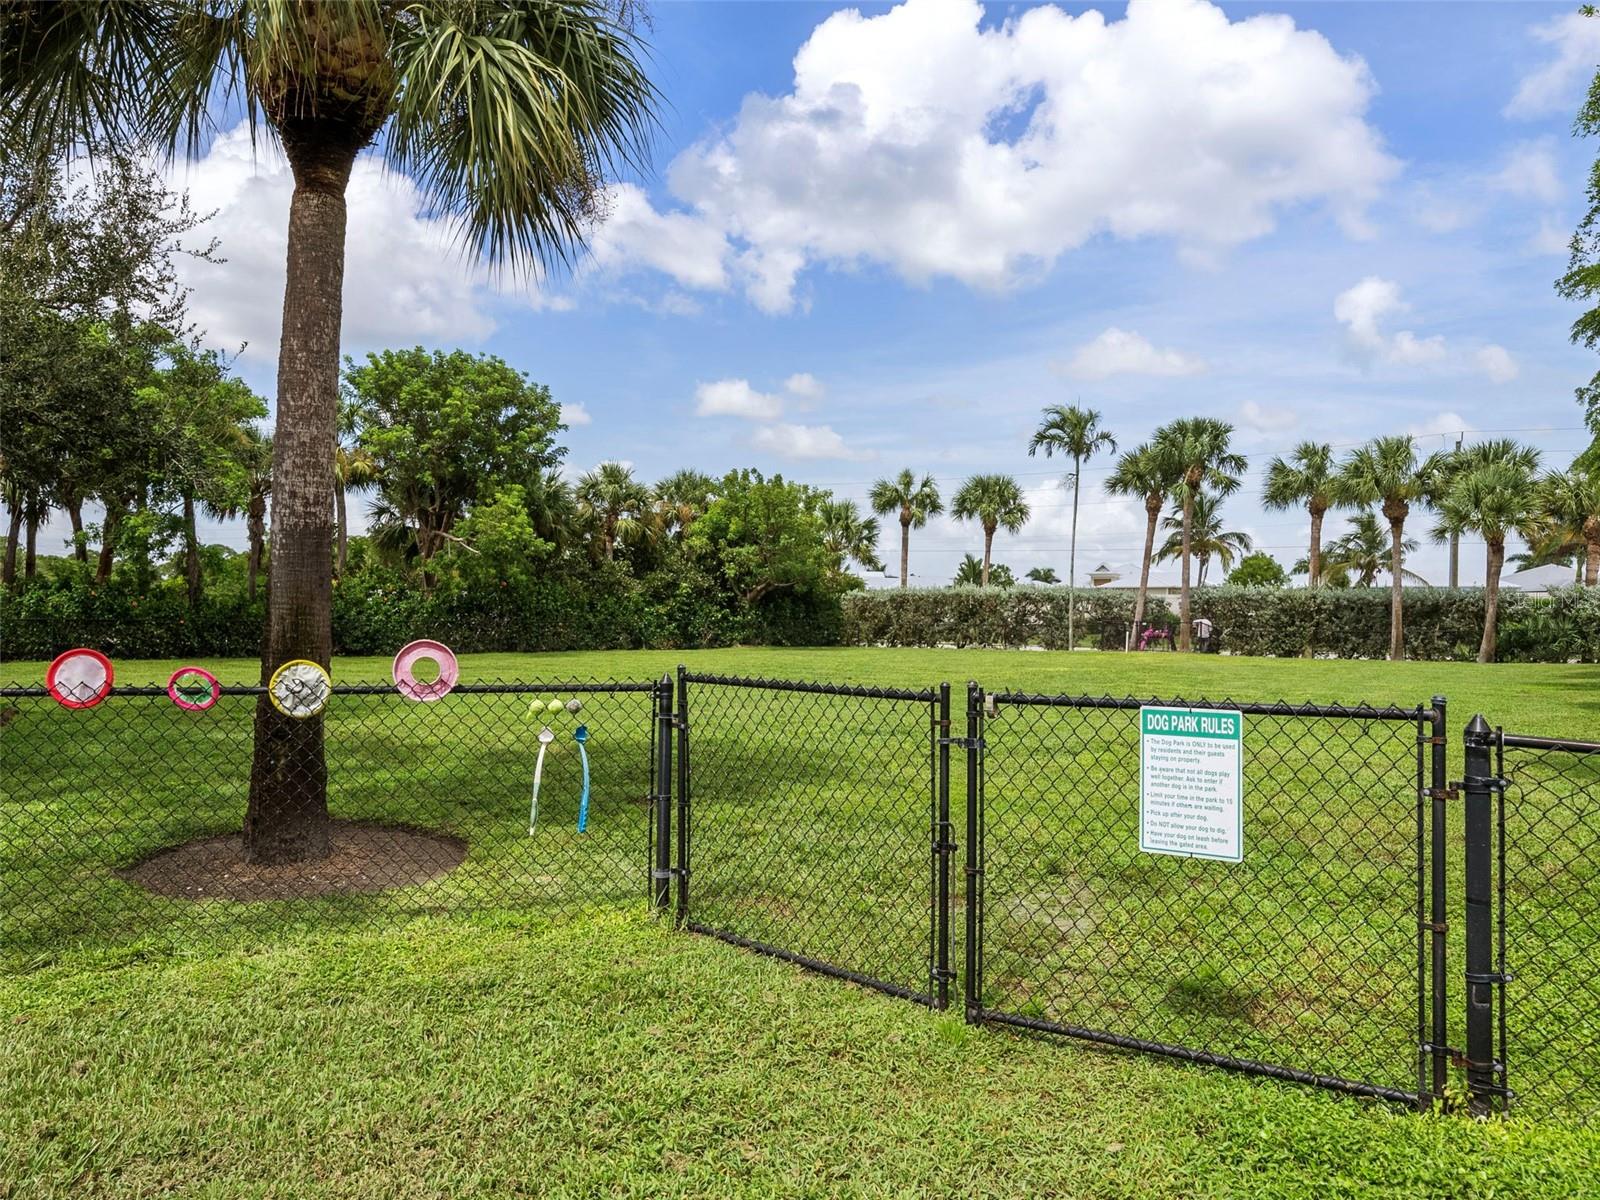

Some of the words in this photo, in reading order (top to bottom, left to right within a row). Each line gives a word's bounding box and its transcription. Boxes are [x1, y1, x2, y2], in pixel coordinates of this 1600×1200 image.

[1148, 714, 1168, 730] DOG
[1172, 716, 1198, 732] PARK
[1201, 717, 1234, 734] RULES
